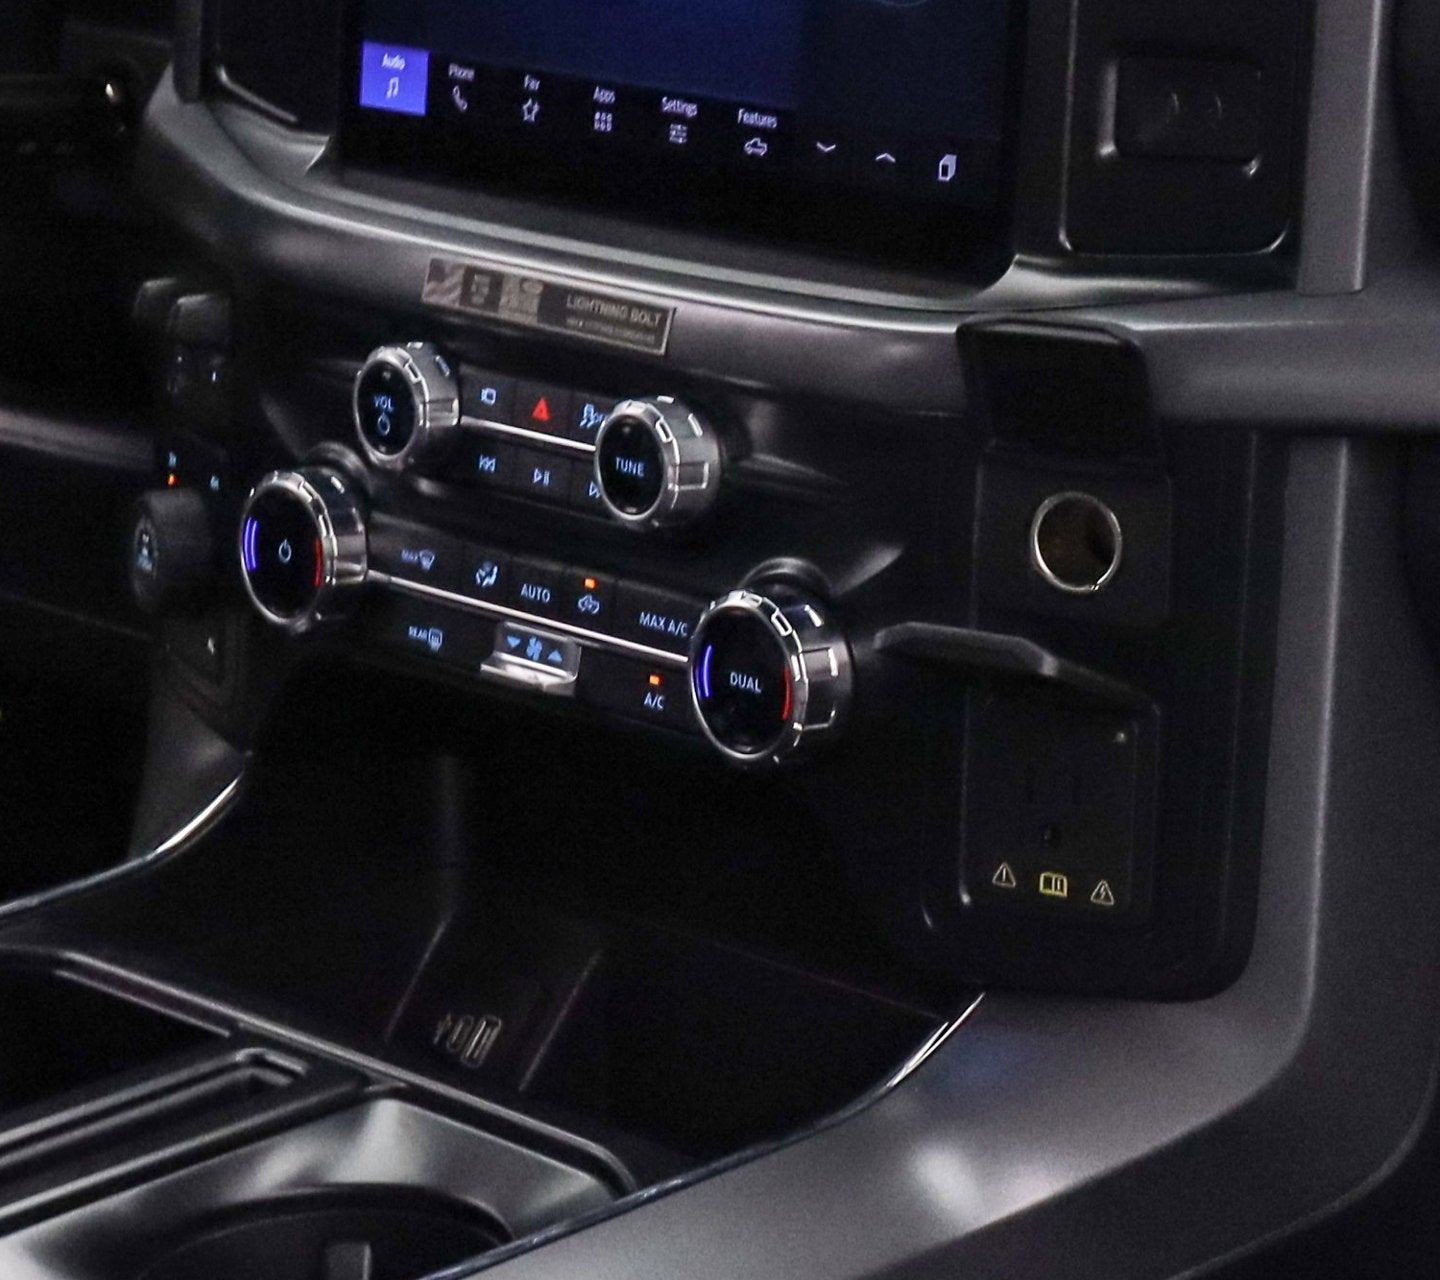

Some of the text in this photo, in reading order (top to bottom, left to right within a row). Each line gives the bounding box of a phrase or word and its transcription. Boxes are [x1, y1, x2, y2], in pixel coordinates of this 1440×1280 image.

[382, 53, 405, 71] Audio
[448, 62, 475, 82] Phone
[593, 86, 616, 105] Apps
[662, 96, 698, 118] Settings
[737, 108, 778, 129] Features
[615, 457, 645, 478] TUNE
[520, 583, 551, 604] AUTO
[640, 611, 688, 637] MAX A/C
[730, 671, 762, 695] DUAL
[643, 691, 665, 711] A/C
